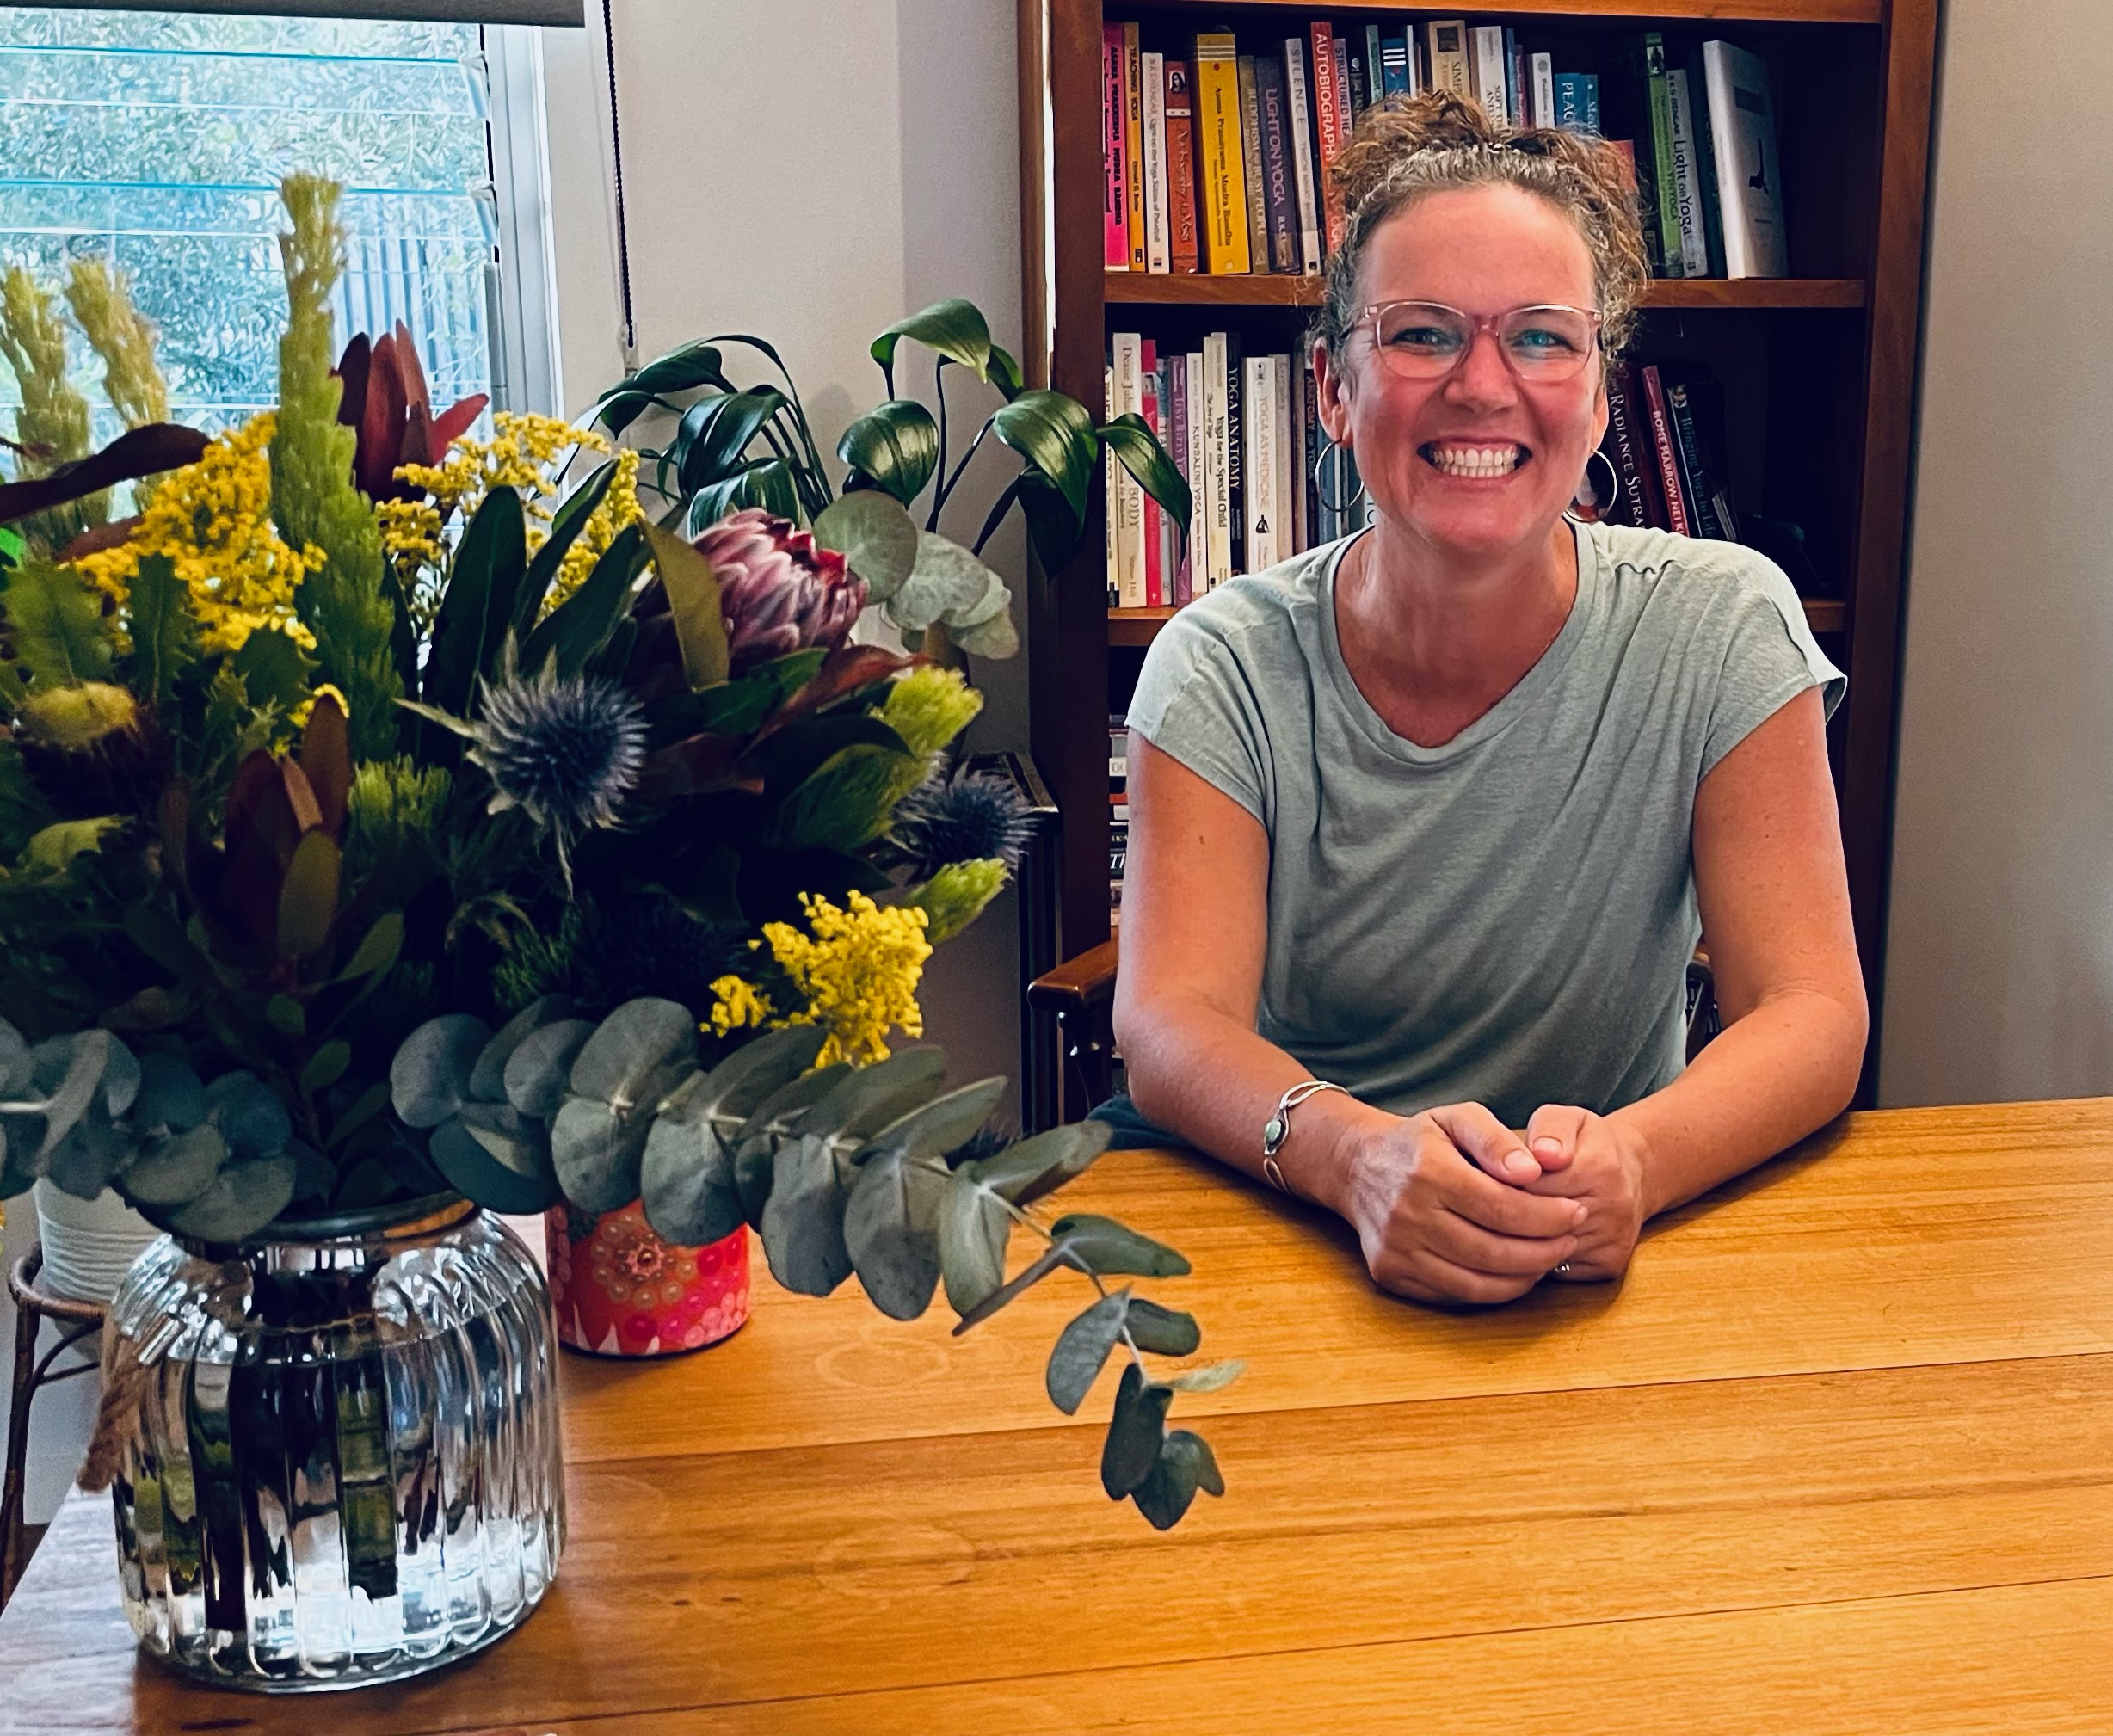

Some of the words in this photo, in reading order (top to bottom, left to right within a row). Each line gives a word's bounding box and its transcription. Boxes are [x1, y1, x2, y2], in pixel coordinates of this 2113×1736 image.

[1129, 47, 1138, 93] TEACHING
[1291, 48, 1307, 125] SILENCE
[1335, 46, 1350, 115] STRUCTURED
[1130, 97, 1139, 121] YOGA
[1562, 82, 1575, 121] PEAC
[1672, 139, 1688, 181] Light
[1221, 175, 1230, 207] Mudra
[1270, 160, 1285, 206] YOGA
[1678, 182, 1686, 197] on
[1256, 197, 1266, 236] PEOPLE
[1677, 194, 1694, 235] Yoga
[1122, 347, 1133, 381] Deane
[1228, 367, 1239, 410] YOGA
[1306, 375, 1316, 431] ANATOMY
[1215, 416, 1225, 440] Yoga
[1259, 397, 1269, 429] YOGA
[1652, 409, 1667, 444] BONE
[1192, 425, 1202, 485] KUNDALINI
[1229, 414, 1241, 490] ANATOMY
[1260, 434, 1269, 449] AS
[1610, 393, 1635, 473] RADIANCE
[1623, 476, 1644, 527] SUTRA
[1679, 416, 1700, 468] Bringing
[1692, 469, 1704, 498] Yoga
[1215, 467, 1227, 502] Special
[1260, 451, 1271, 509] MEDICINE
[1659, 445, 1678, 499] MARROW
[1128, 487, 1140, 529] BODY
[1192, 487, 1203, 515] YOGA
[1218, 503, 1228, 528] Child
[1670, 500, 1682, 521] NEI
